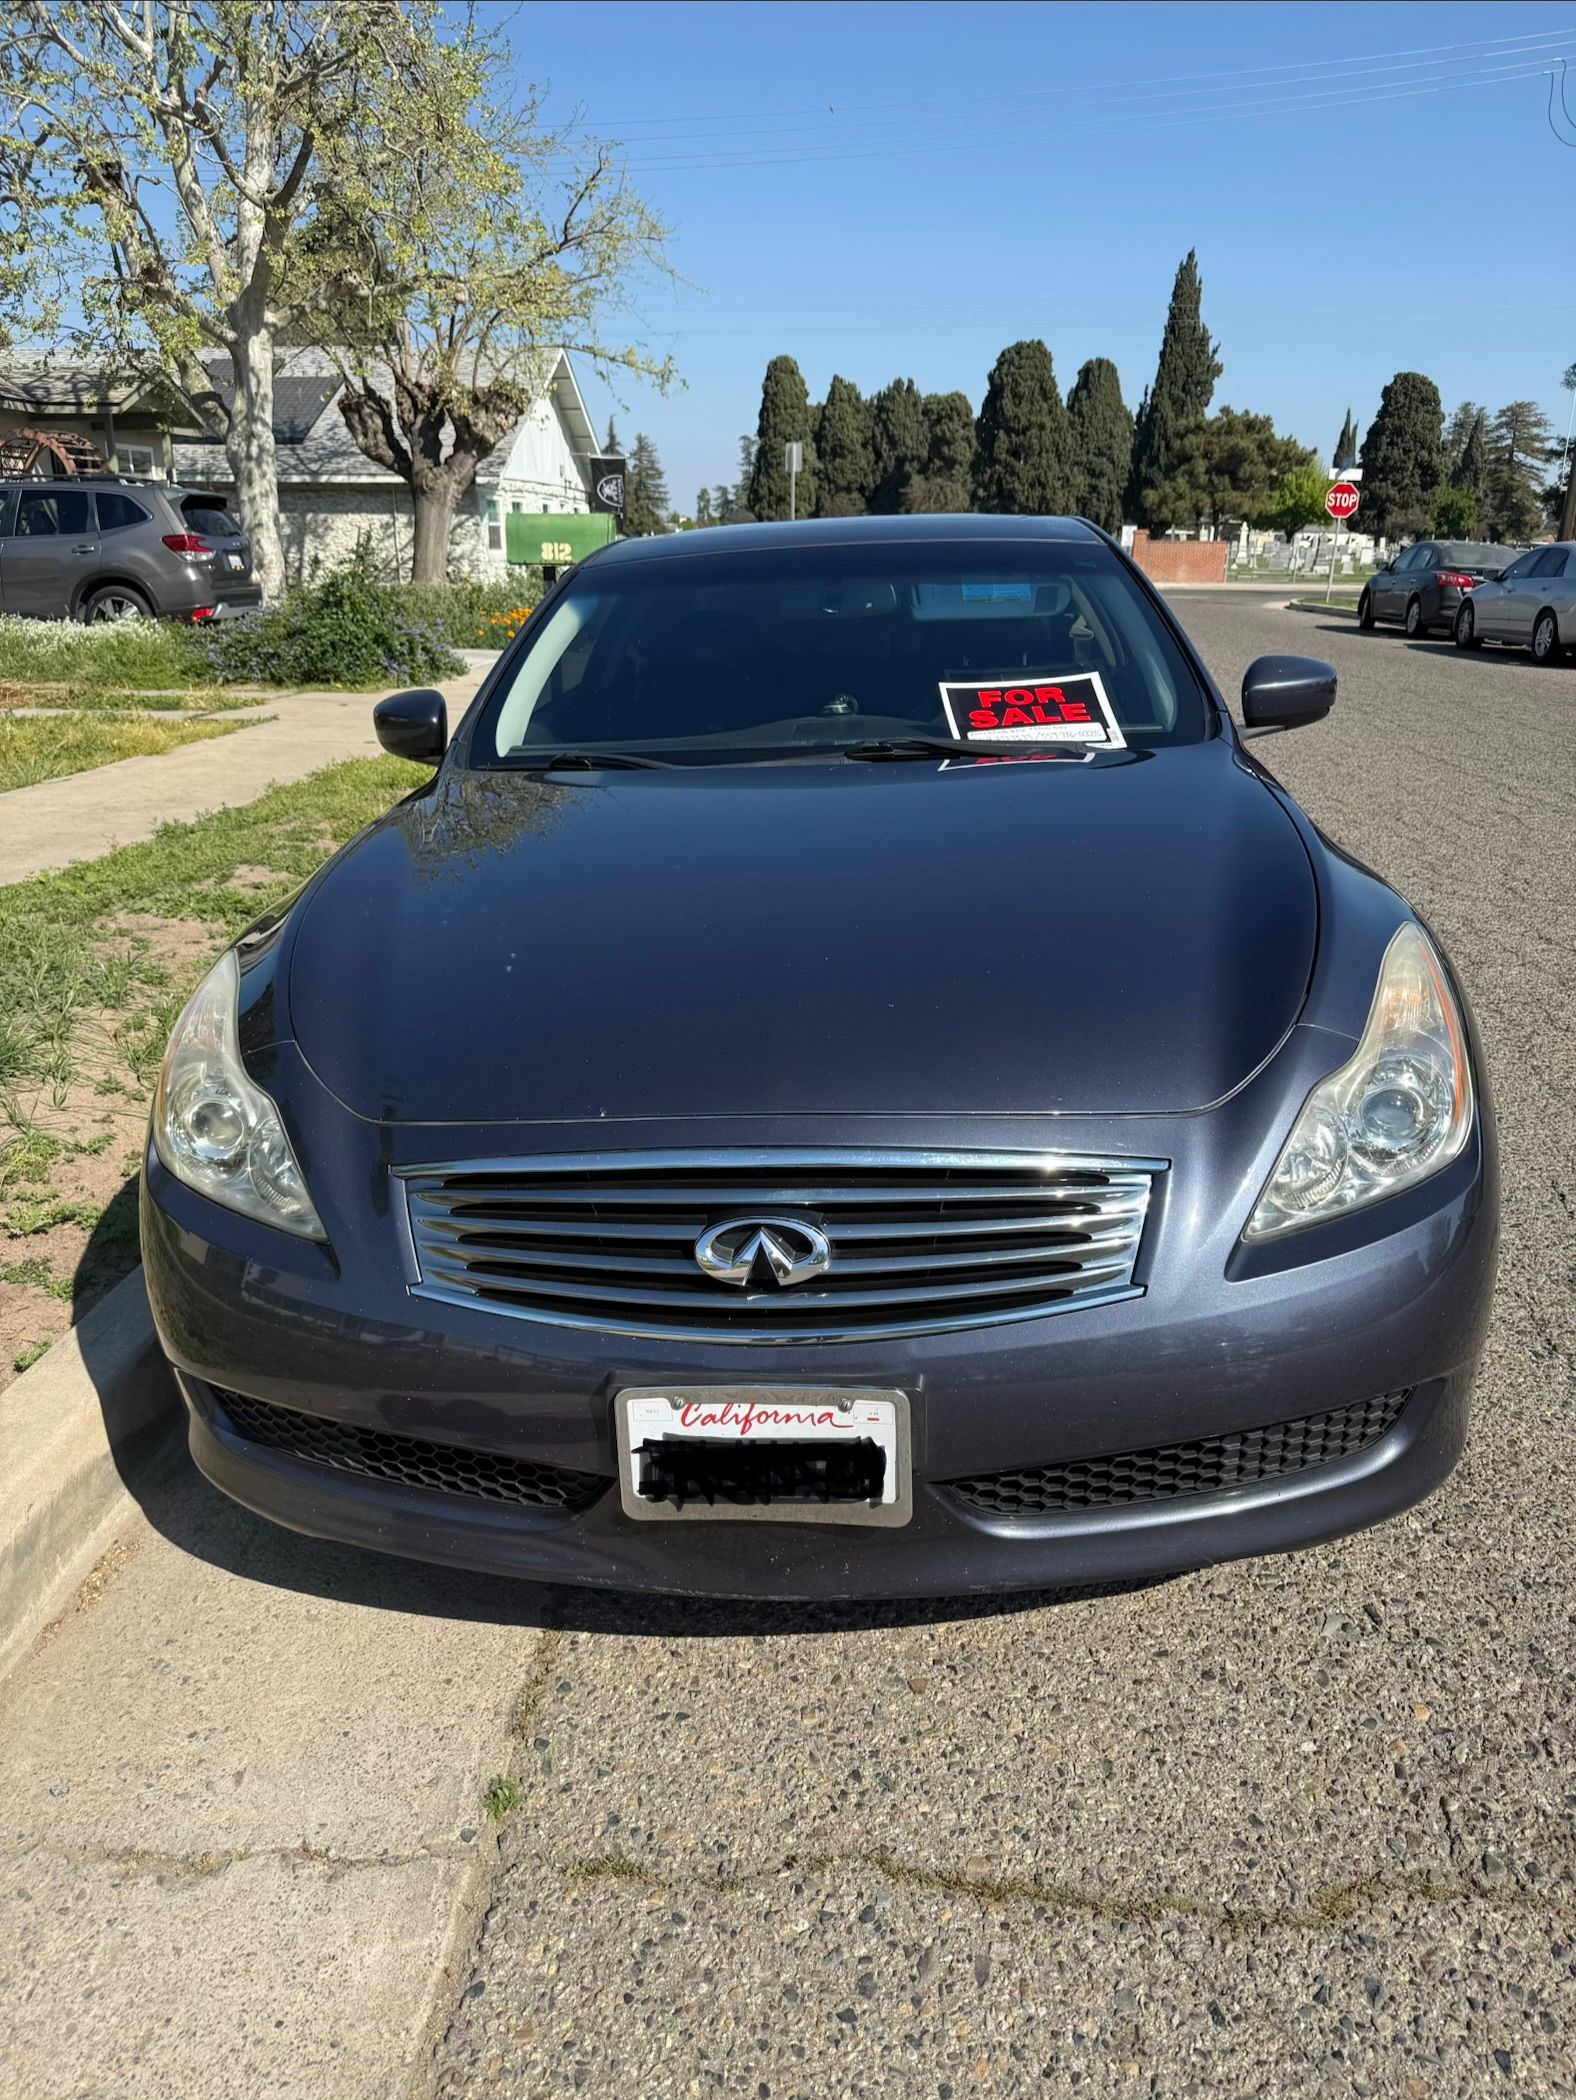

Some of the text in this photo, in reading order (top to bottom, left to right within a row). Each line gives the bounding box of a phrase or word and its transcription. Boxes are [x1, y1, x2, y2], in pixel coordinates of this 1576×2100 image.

[1327, 493, 1357, 507] STOP
[541, 542, 572, 561] 812
[977, 686, 1066, 709] FOR
[968, 702, 1092, 729] SALE
[680, 1401, 854, 1436] California
